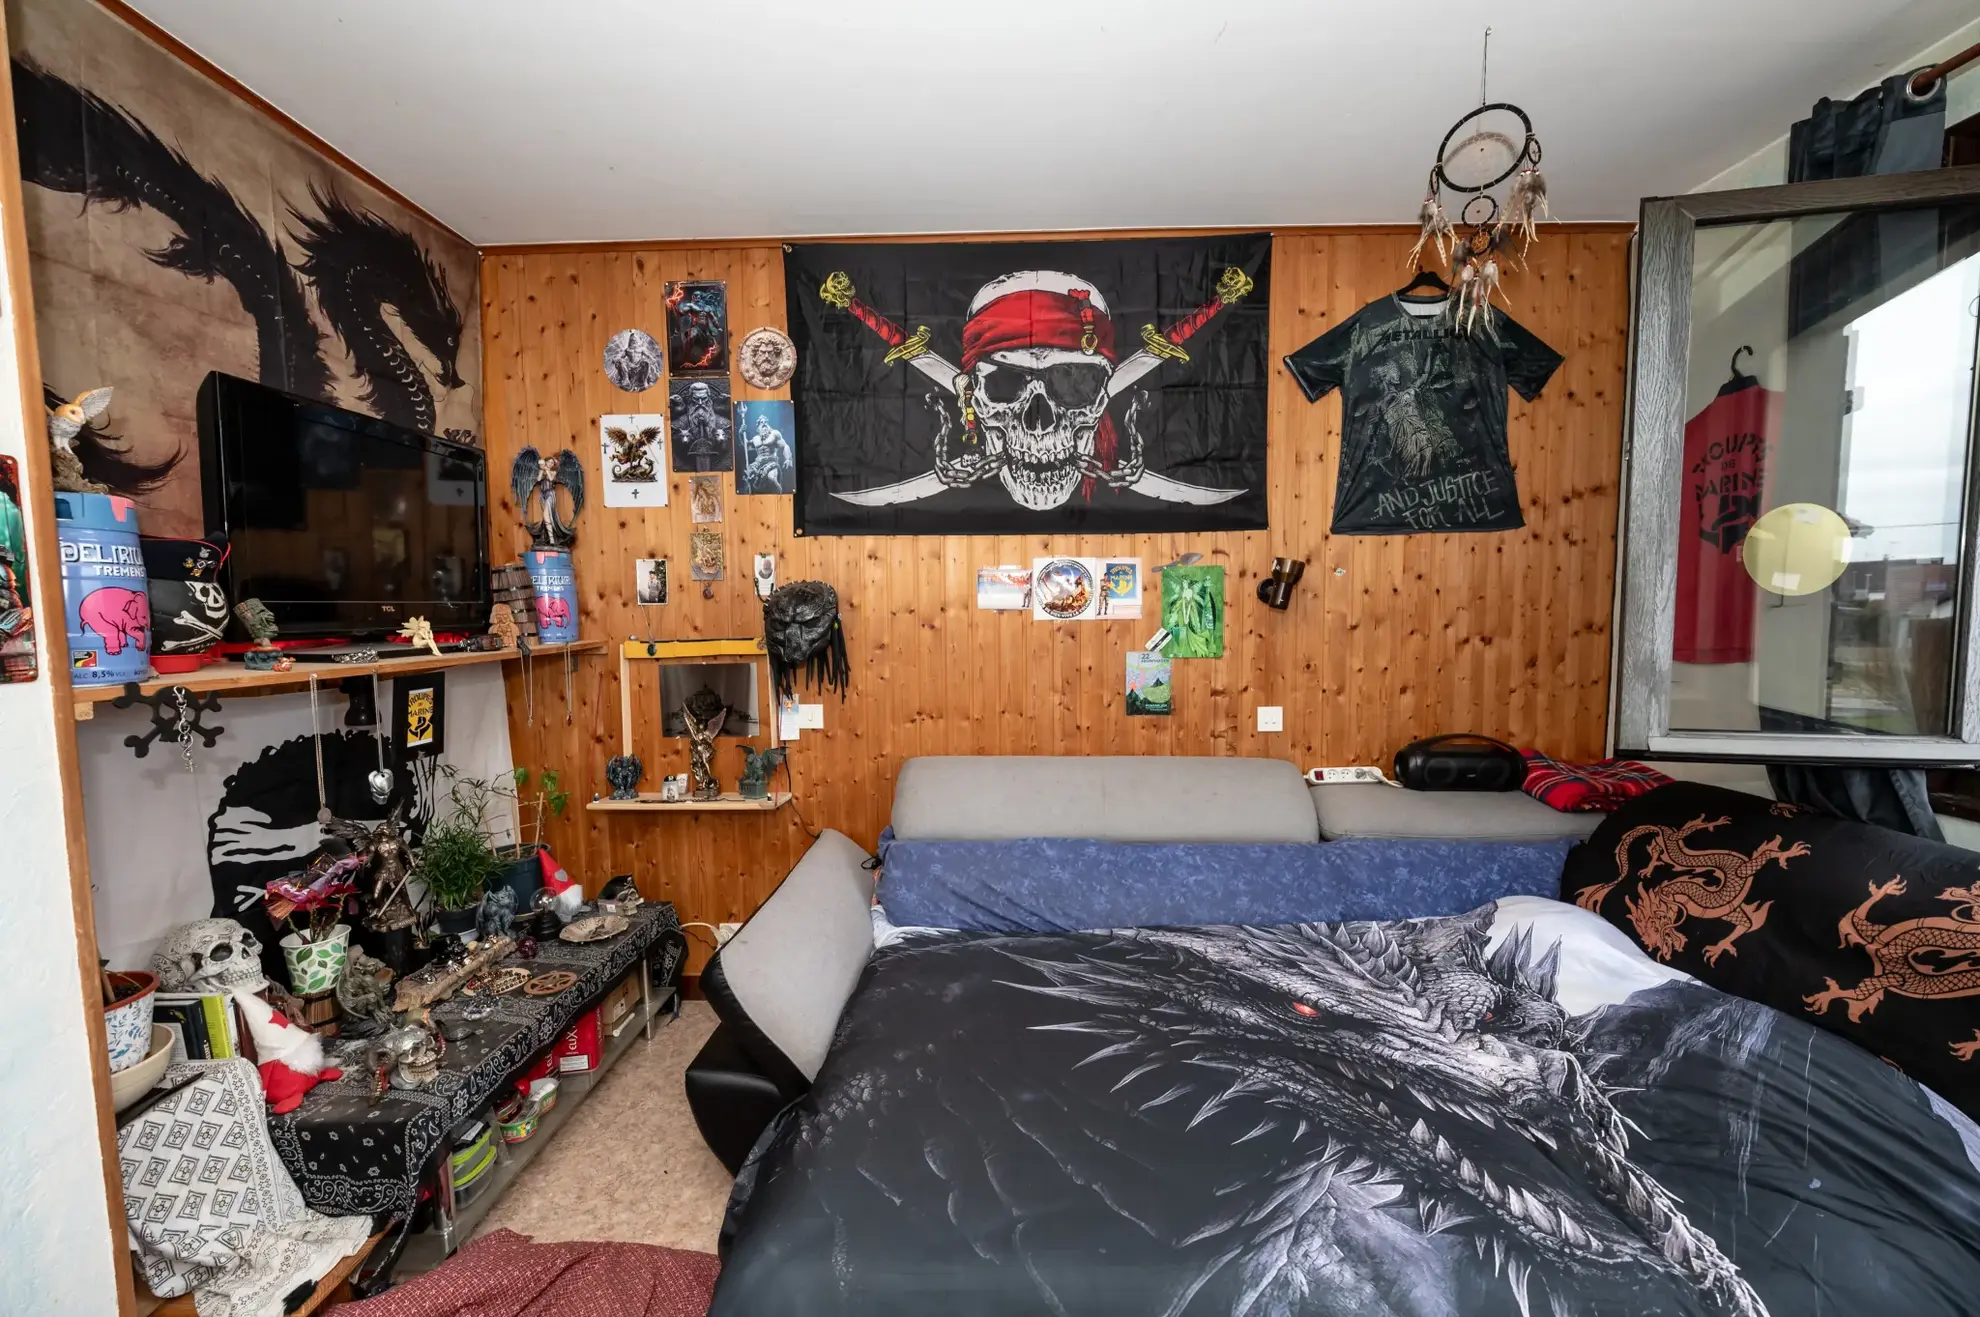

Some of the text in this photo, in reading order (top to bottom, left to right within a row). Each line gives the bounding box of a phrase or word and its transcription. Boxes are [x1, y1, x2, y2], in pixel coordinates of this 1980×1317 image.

[1419, 470, 1500, 506] JUSTICE
[1402, 497, 1504, 529] FOR ALL
[59, 541, 144, 565] DELIRIU
[93, 565, 146, 577] TREMENS
[92, 671, 114, 679] 8,5%
